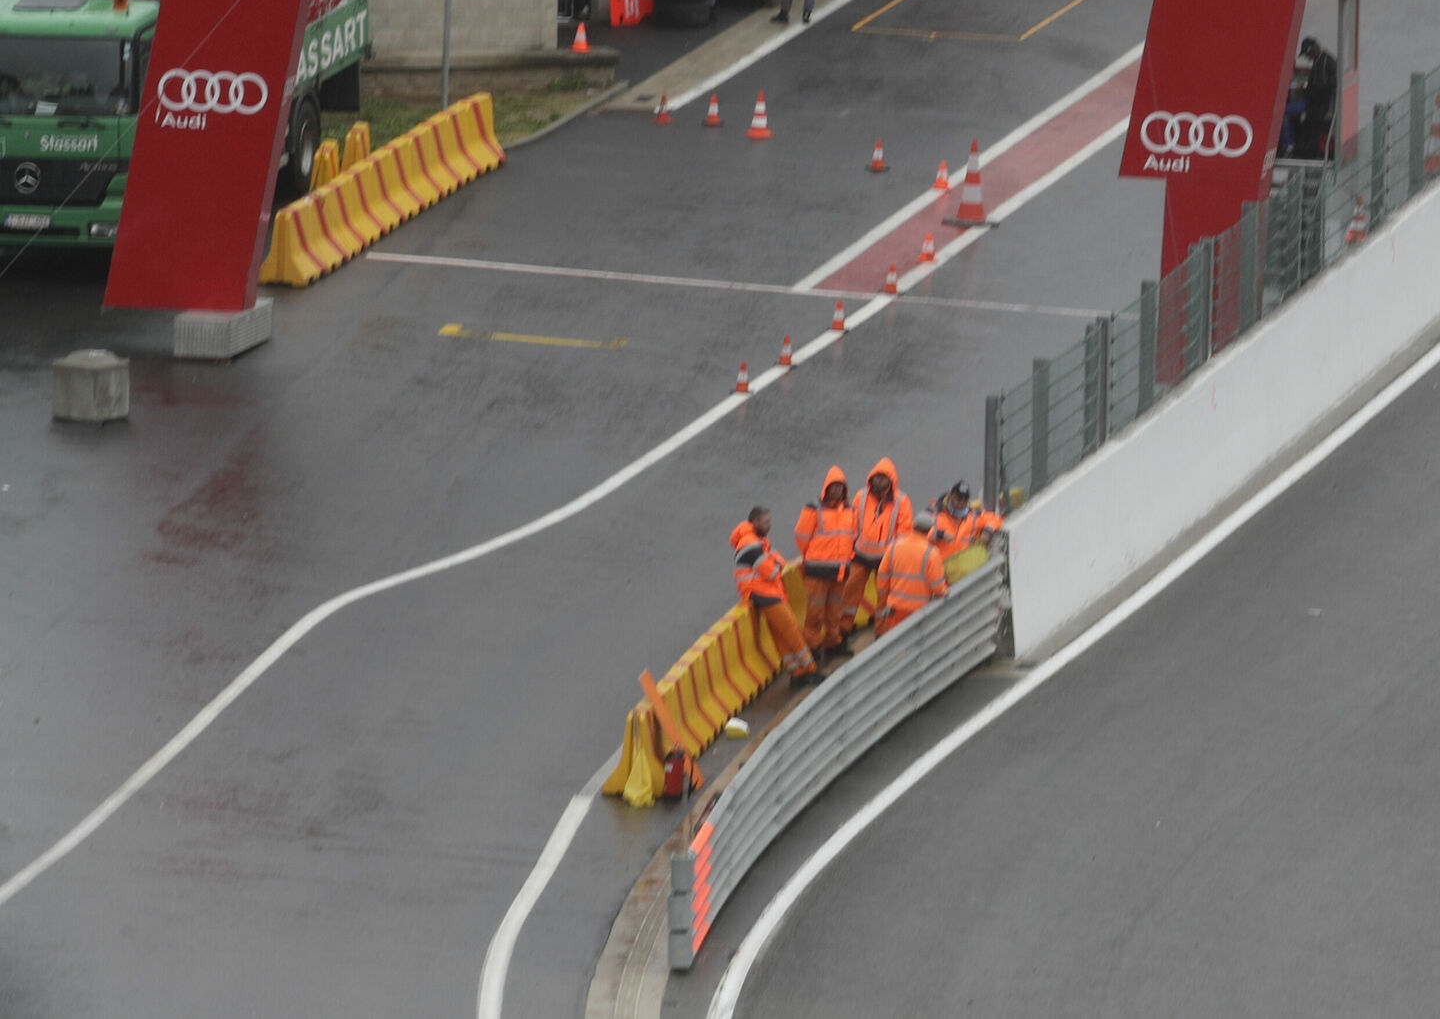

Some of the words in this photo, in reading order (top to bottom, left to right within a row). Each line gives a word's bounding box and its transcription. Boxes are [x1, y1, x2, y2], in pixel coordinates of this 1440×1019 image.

[161, 111, 208, 131] Audi
[39, 133, 99, 153] Stassart
[1143, 153, 1191, 173] Audi
